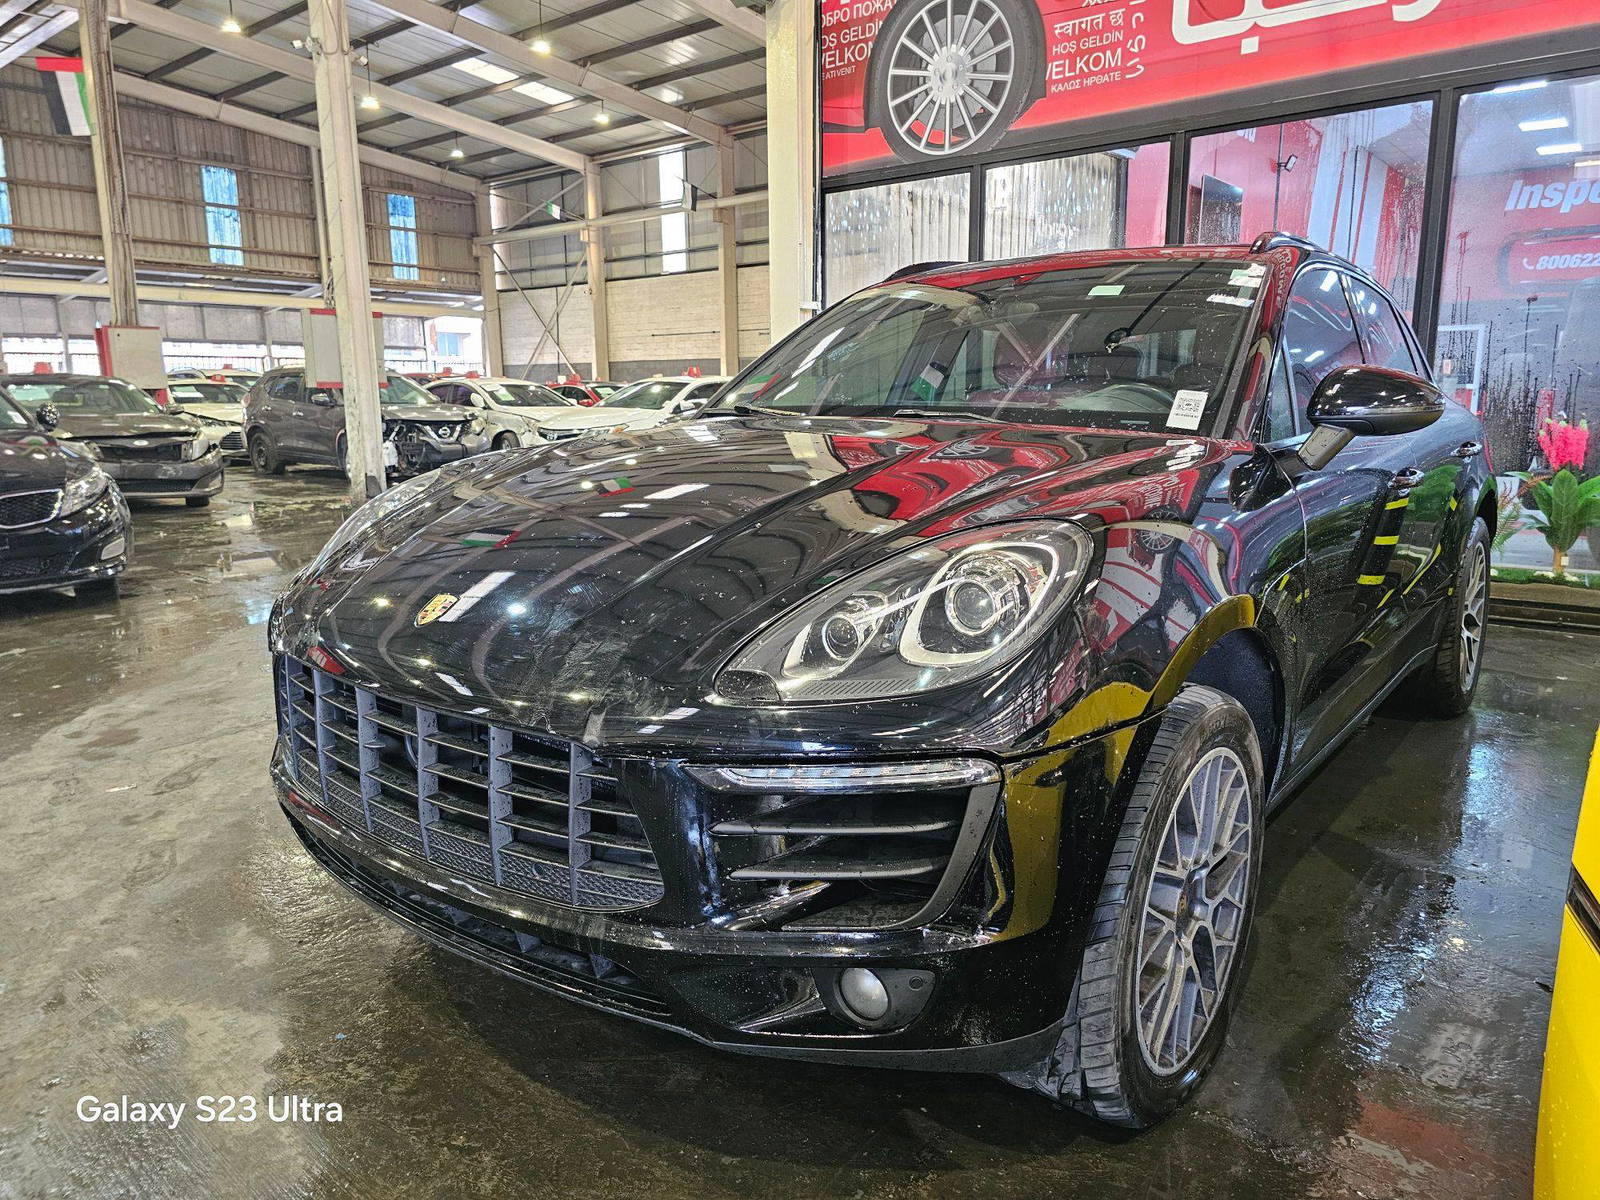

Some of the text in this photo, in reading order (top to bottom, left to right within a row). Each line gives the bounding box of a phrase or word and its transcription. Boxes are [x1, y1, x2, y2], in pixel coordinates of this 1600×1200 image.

[1052, 29, 1124, 56] HOŞ GELDİN
[1046, 47, 1122, 80] ELKOM
